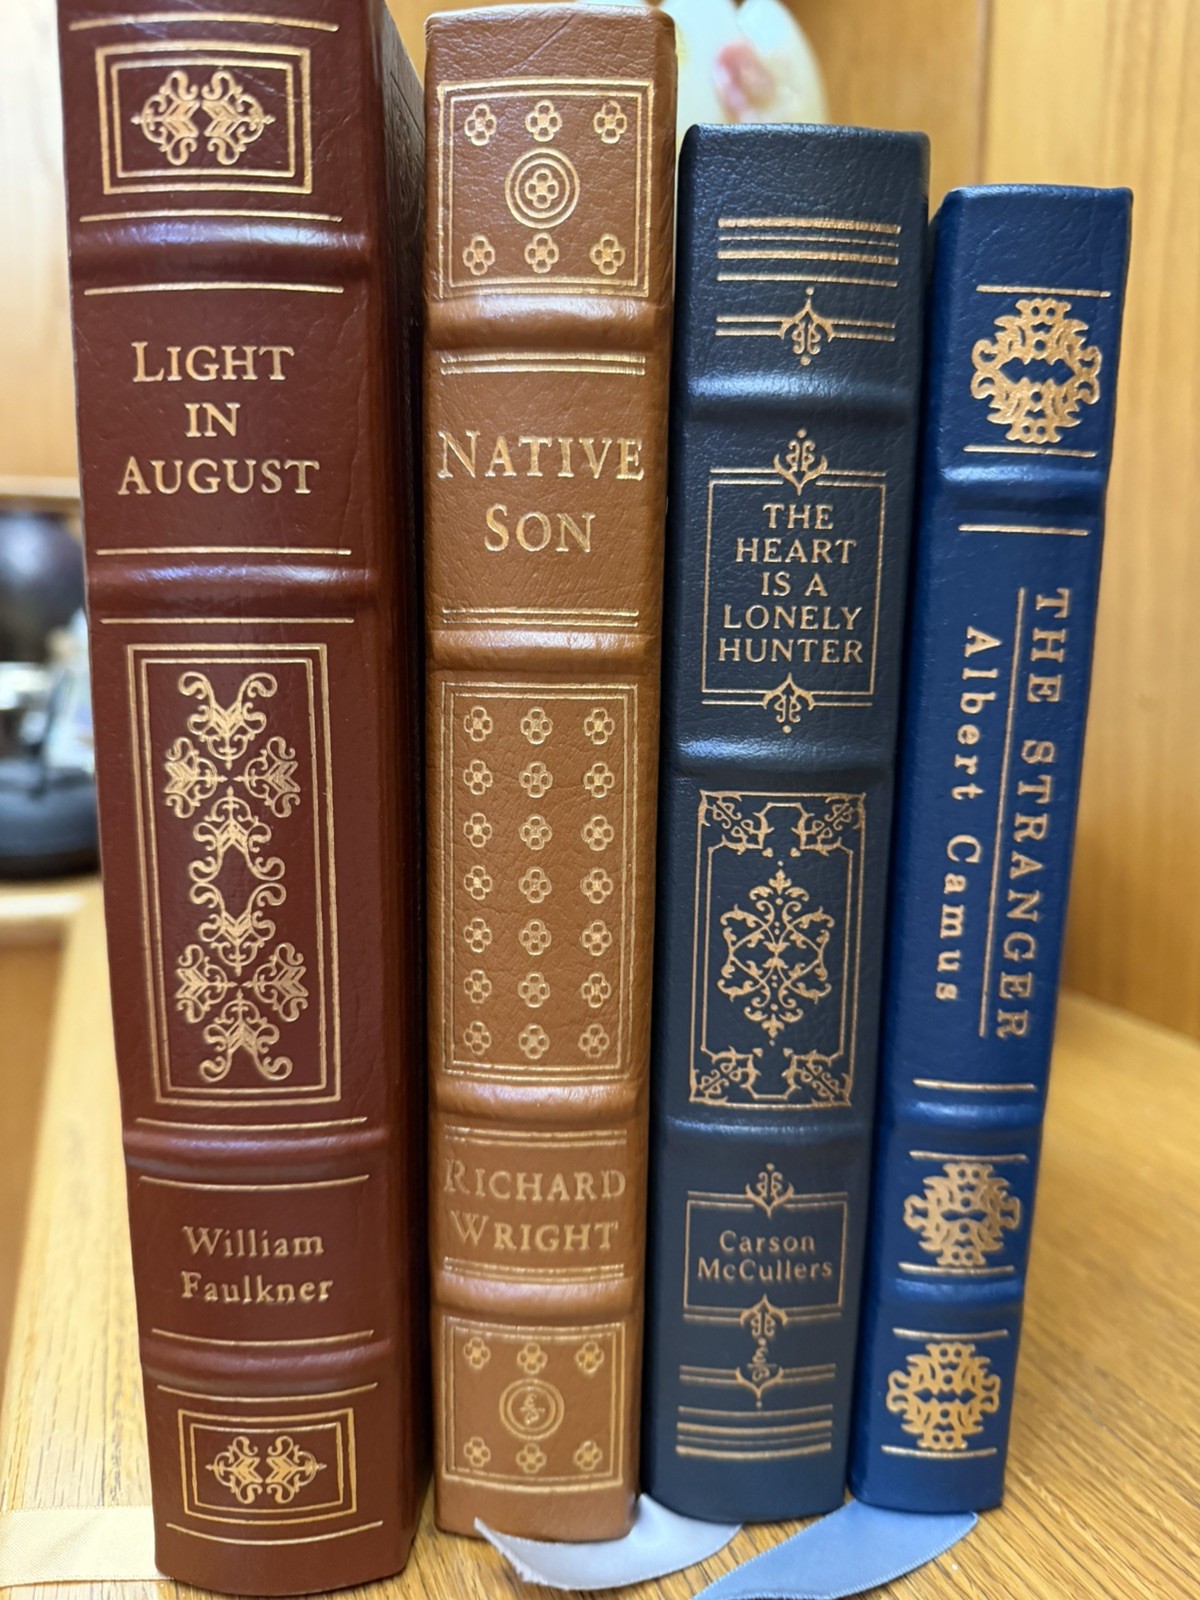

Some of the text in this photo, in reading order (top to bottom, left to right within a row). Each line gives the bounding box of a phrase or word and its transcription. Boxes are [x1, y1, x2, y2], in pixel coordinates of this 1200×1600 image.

[131, 341, 294, 384] LIGHT
[184, 402, 240, 438] IN
[436, 429, 643, 481] NATIVE
[117, 456, 320, 495] AUGUST
[483, 503, 595, 553] SON
[762, 503, 834, 530] THE
[735, 537, 857, 564] HEART
[761, 571, 828, 597] IS A
[724, 603, 862, 630] LONELY
[718, 637, 863, 663] HUNTER
[935, 625, 1003, 1001] Albert Camus
[996, 588, 1070, 1038] THE STRANGER
[443, 1157, 627, 1202] RICHARD
[181, 1225, 324, 1258] William
[450, 1210, 620, 1253] WRIGHT
[719, 1229, 816, 1254] Carson
[697, 1256, 834, 1282] McCullers
[180, 1270, 333, 1304] Faulkner
